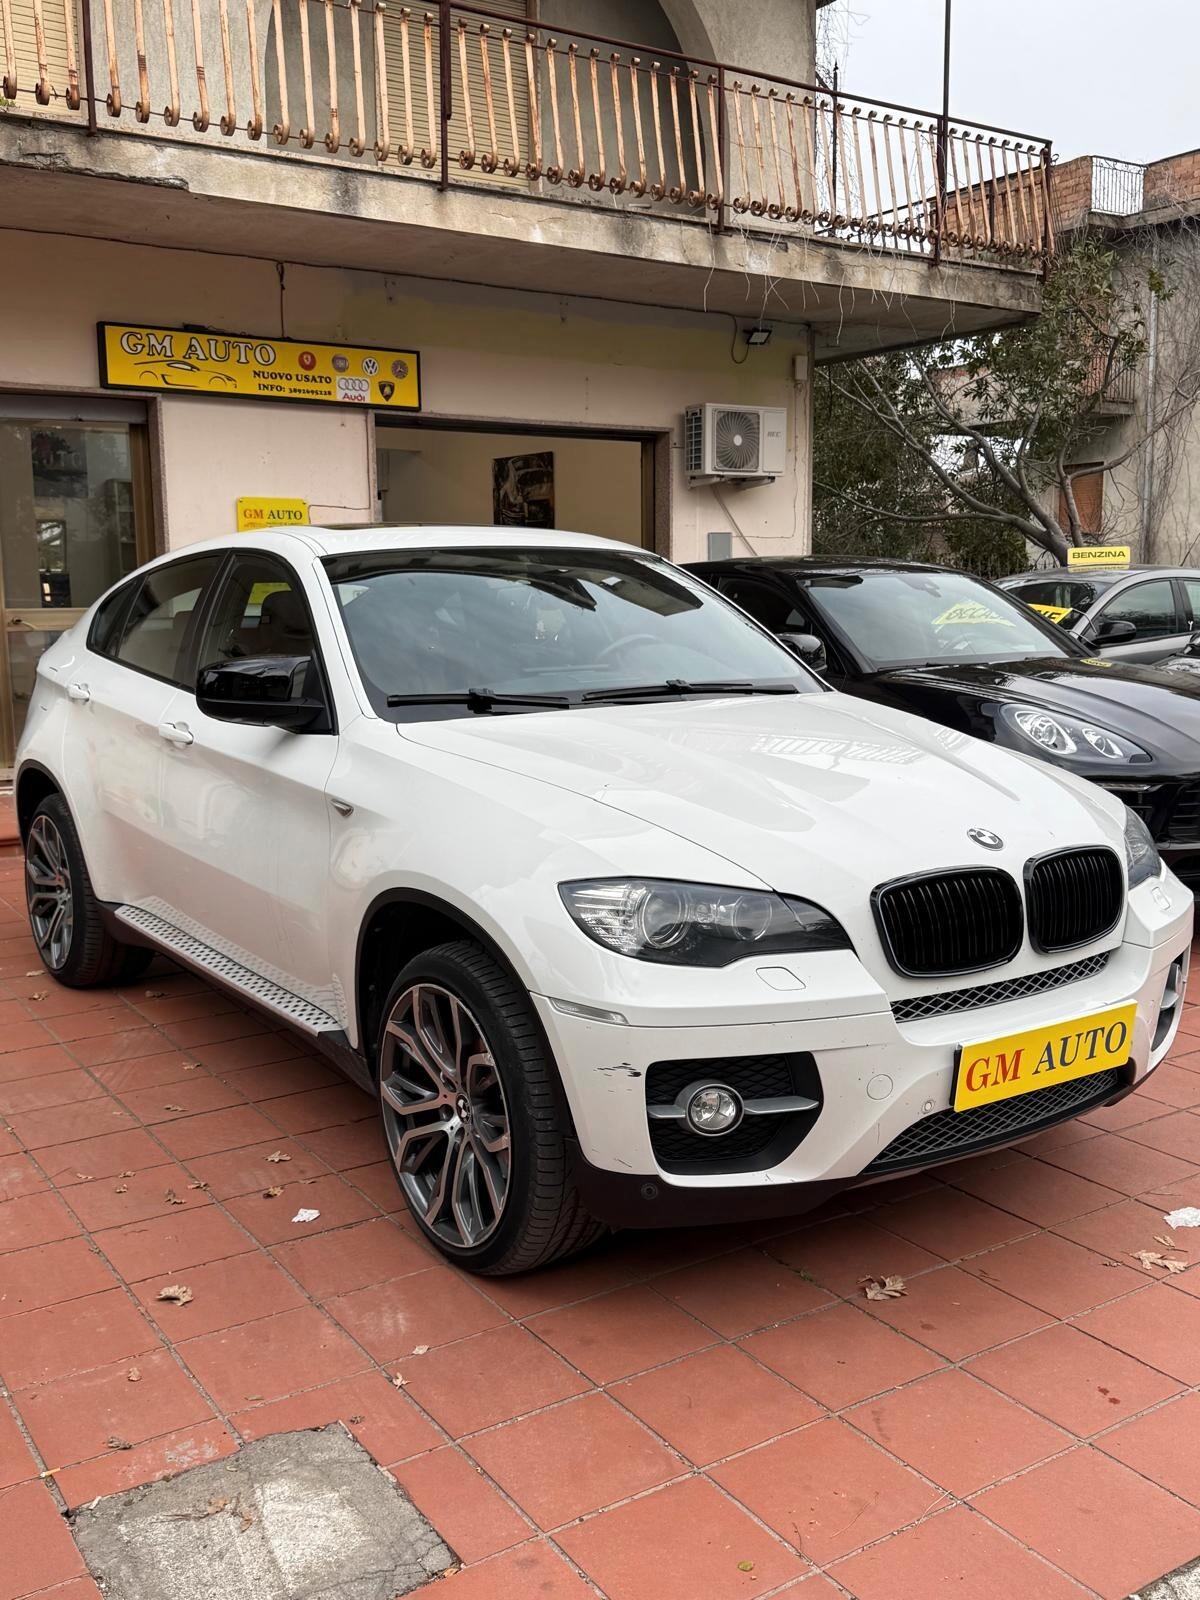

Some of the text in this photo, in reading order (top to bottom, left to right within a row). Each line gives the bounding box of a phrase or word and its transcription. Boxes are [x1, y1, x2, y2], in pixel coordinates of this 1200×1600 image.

[120, 331, 277, 366] GM AUTO
[252, 370, 332, 384] NUOVO USATO
[258, 383, 286, 393] INFO:
[342, 392, 366, 402] Audi
[243, 508, 303, 521] GM AUTO
[1072, 551, 1126, 559] BENZINA
[966, 1021, 1127, 1092] GM AUTO
